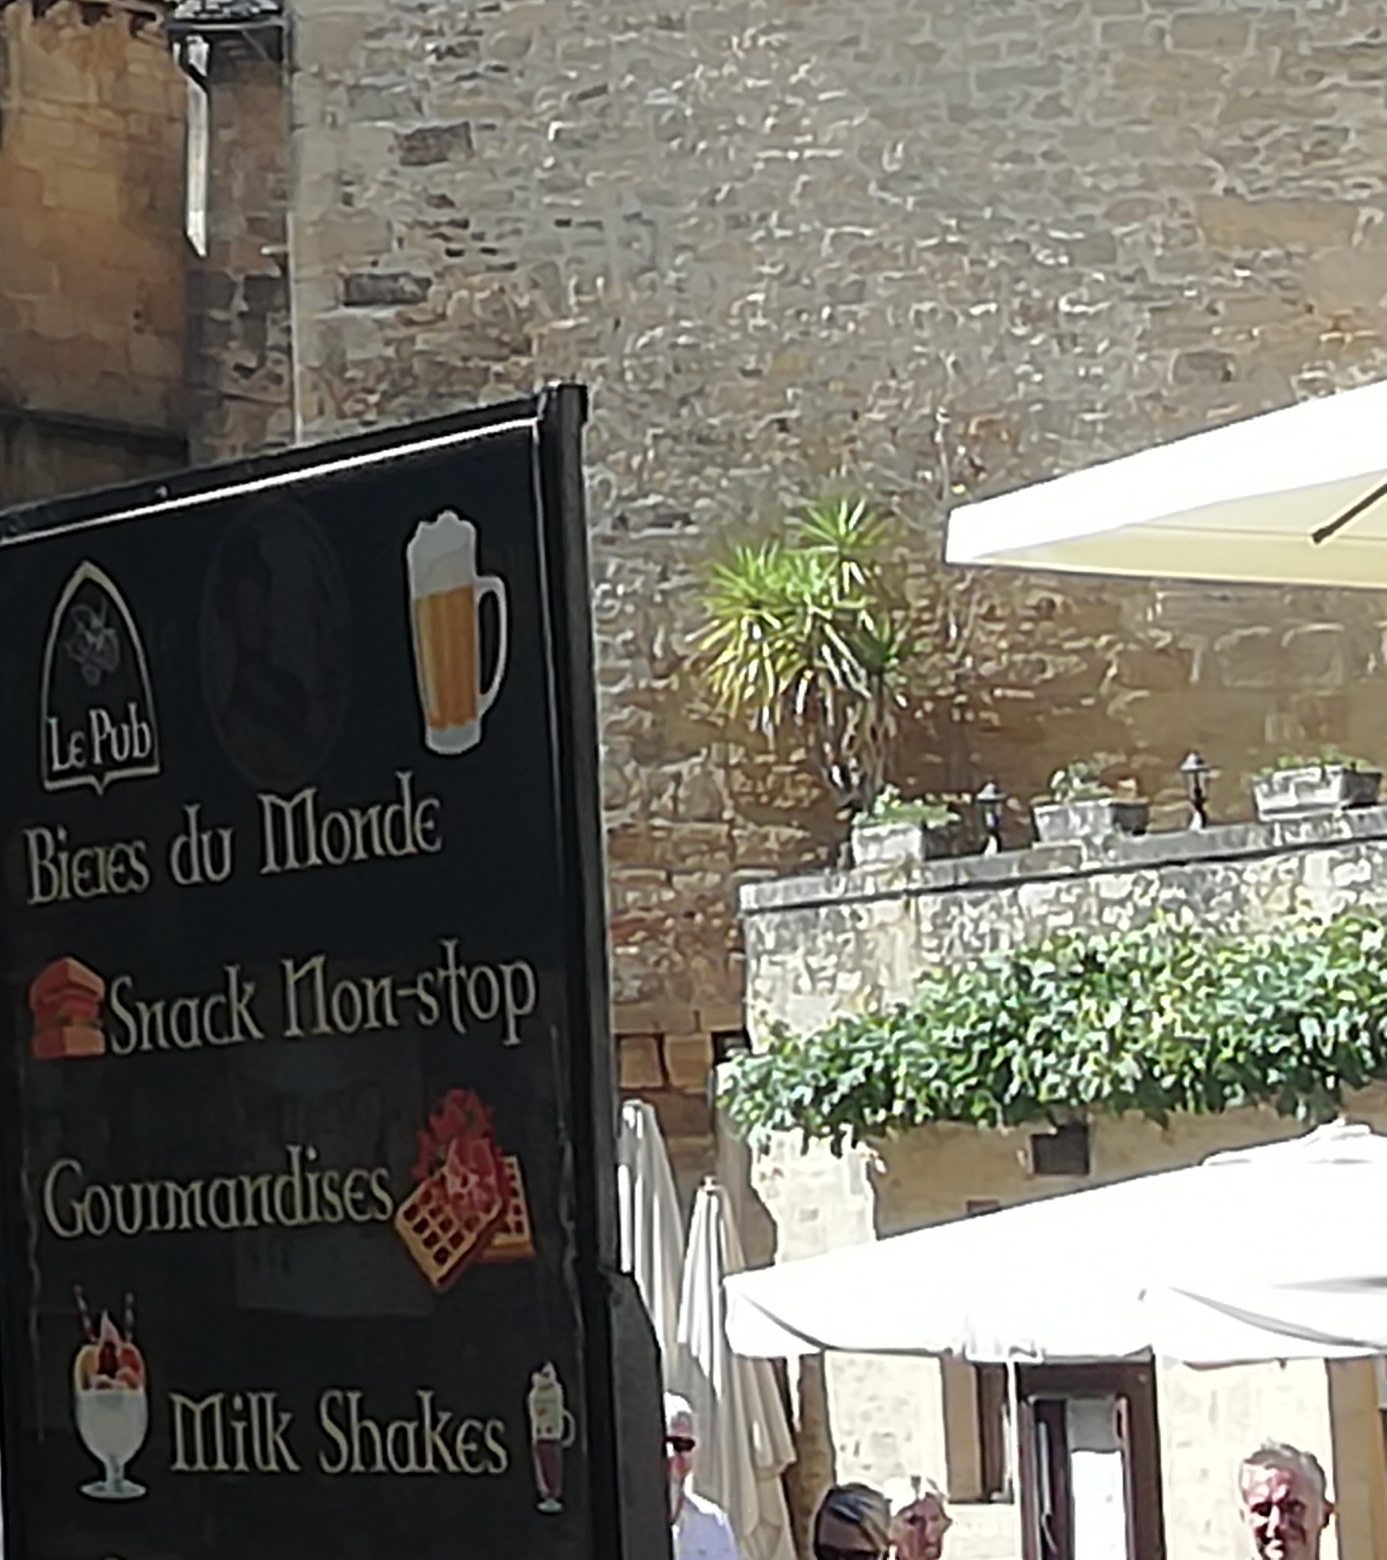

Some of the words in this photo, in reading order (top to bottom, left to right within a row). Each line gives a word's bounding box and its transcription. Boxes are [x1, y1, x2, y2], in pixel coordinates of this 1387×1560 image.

[46, 716, 86, 771] Le
[89, 702, 153, 766] Pub
[169, 805, 233, 886] du
[258, 771, 444, 876] Monde
[108, 964, 264, 1056] Snack
[280, 939, 537, 1046] Non-stop
[42, 1144, 395, 1239] Gourmandises
[169, 1390, 301, 1474] Milk
[318, 1388, 510, 1476] Shakes
